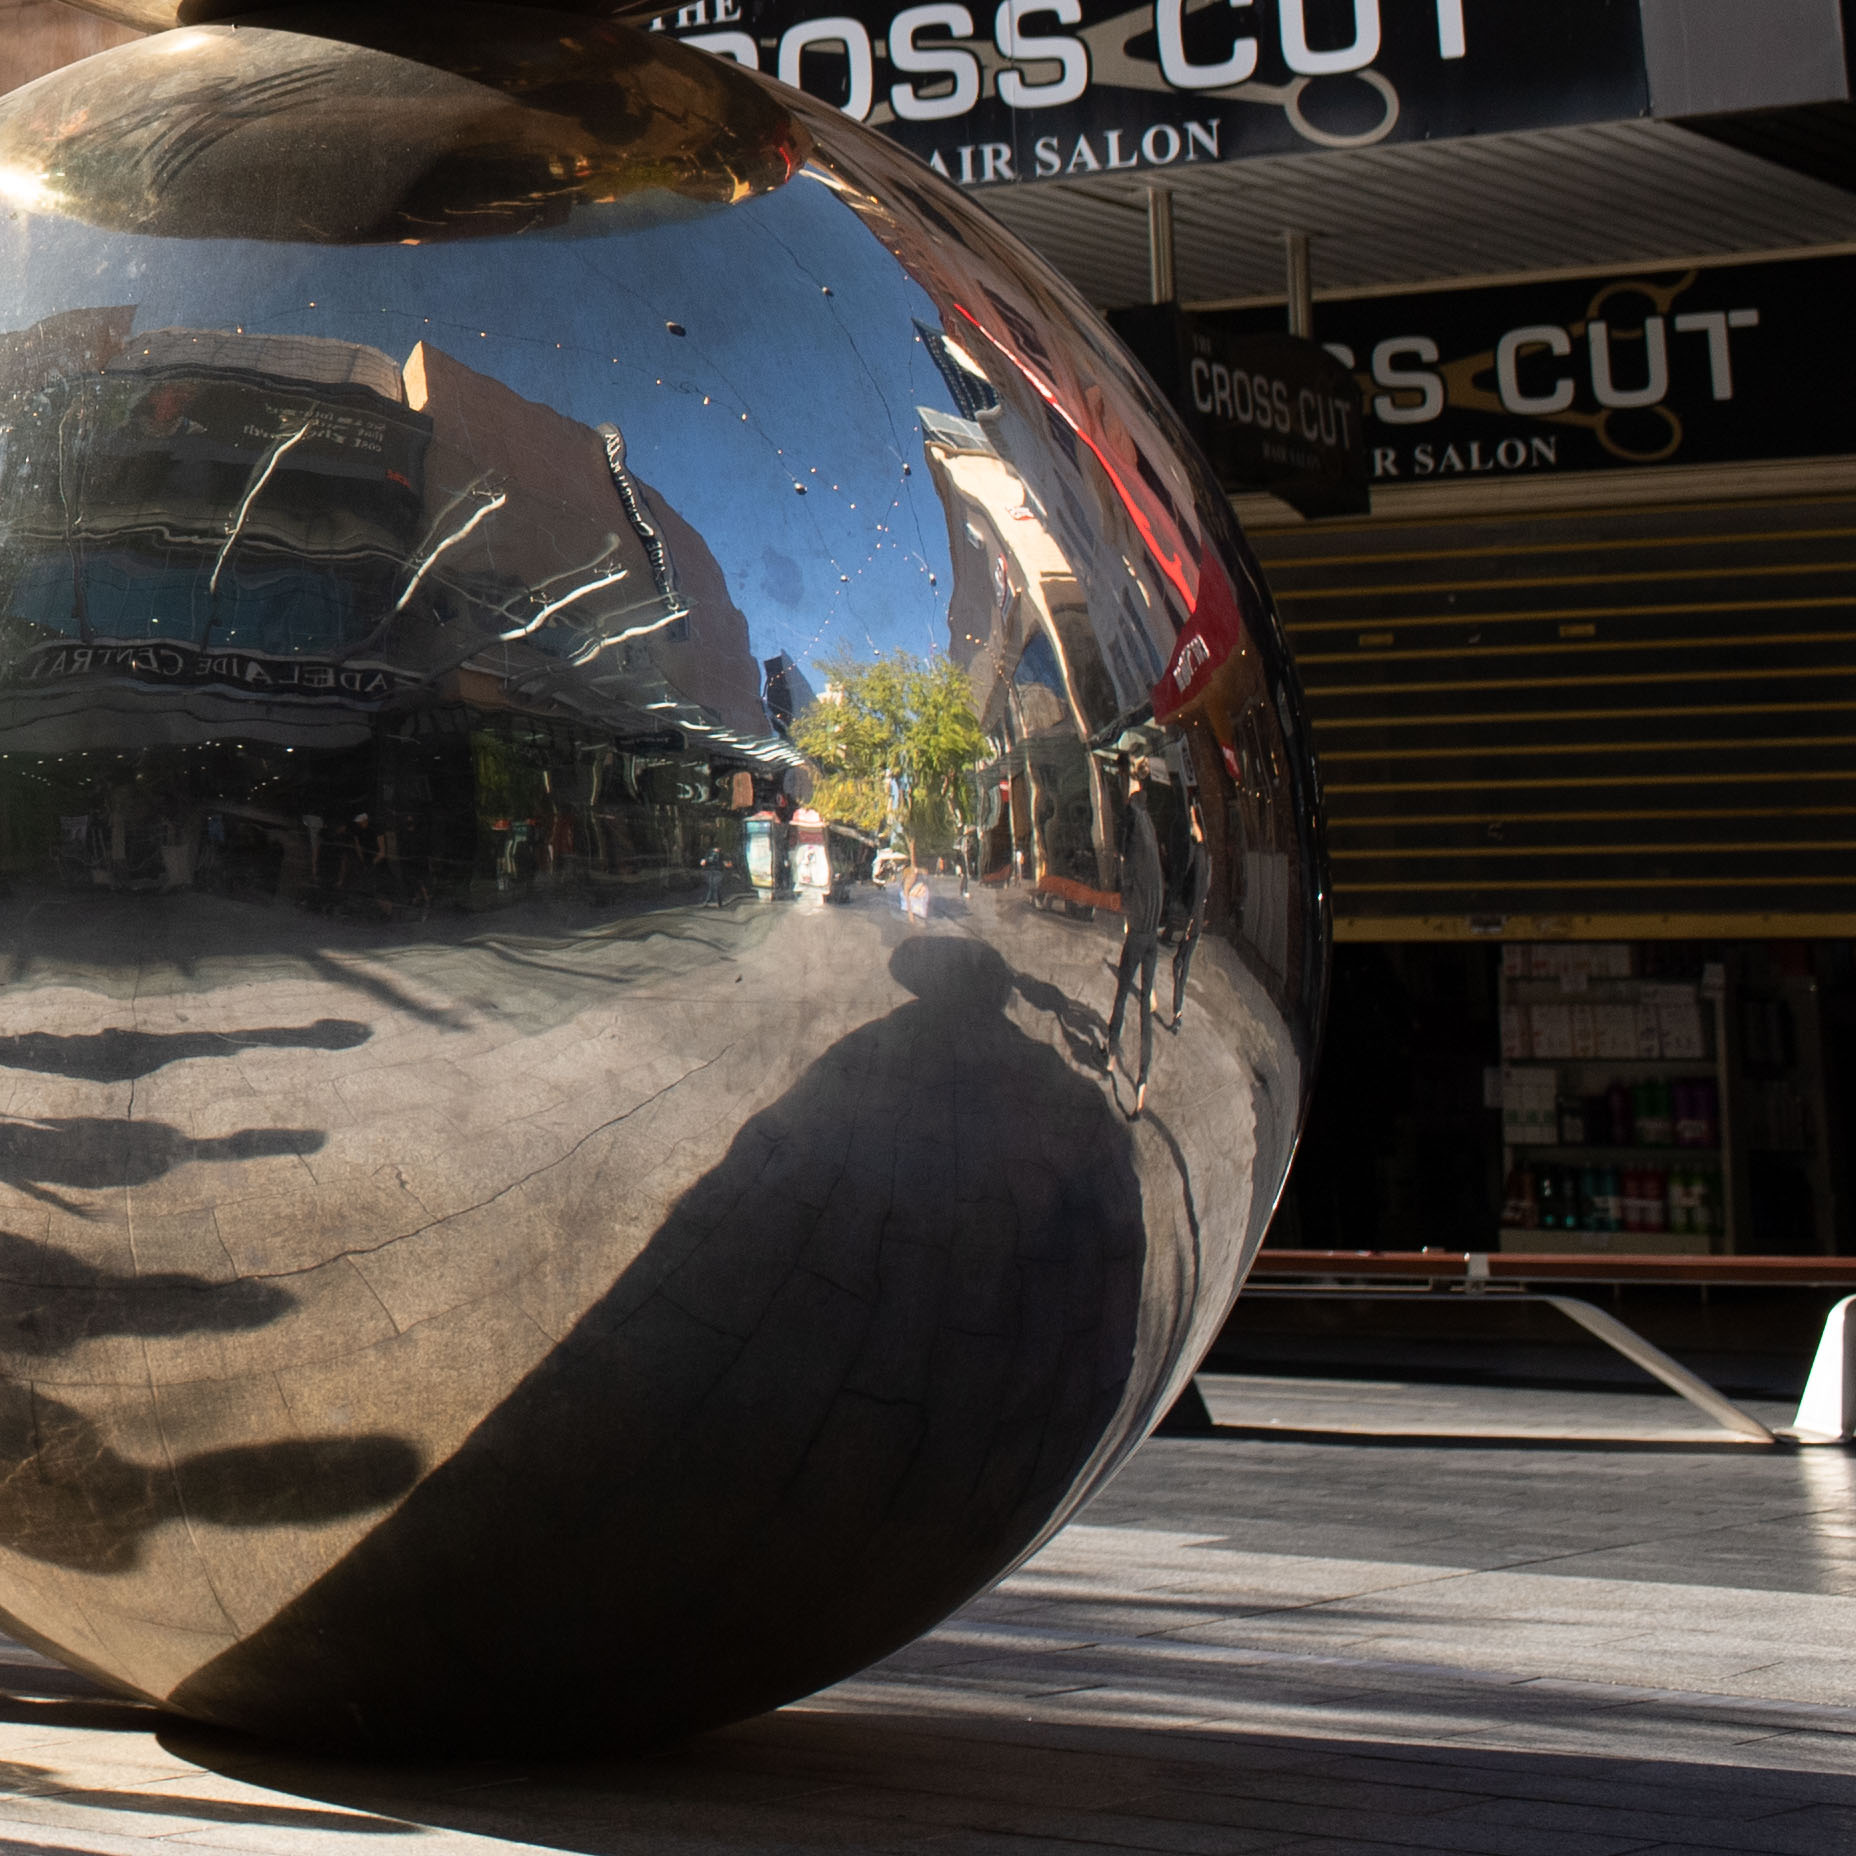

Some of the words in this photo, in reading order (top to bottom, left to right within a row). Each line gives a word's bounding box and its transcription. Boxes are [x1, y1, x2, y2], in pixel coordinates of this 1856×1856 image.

[929, 142, 1016, 185] AIR
[1034, 117, 1222, 178] SALON
[1496, 308, 1759, 416] CUT
[1190, 356, 1292, 435] CROSS
[1298, 387, 1352, 451] CUT
[1414, 435, 1558, 477] SALON
